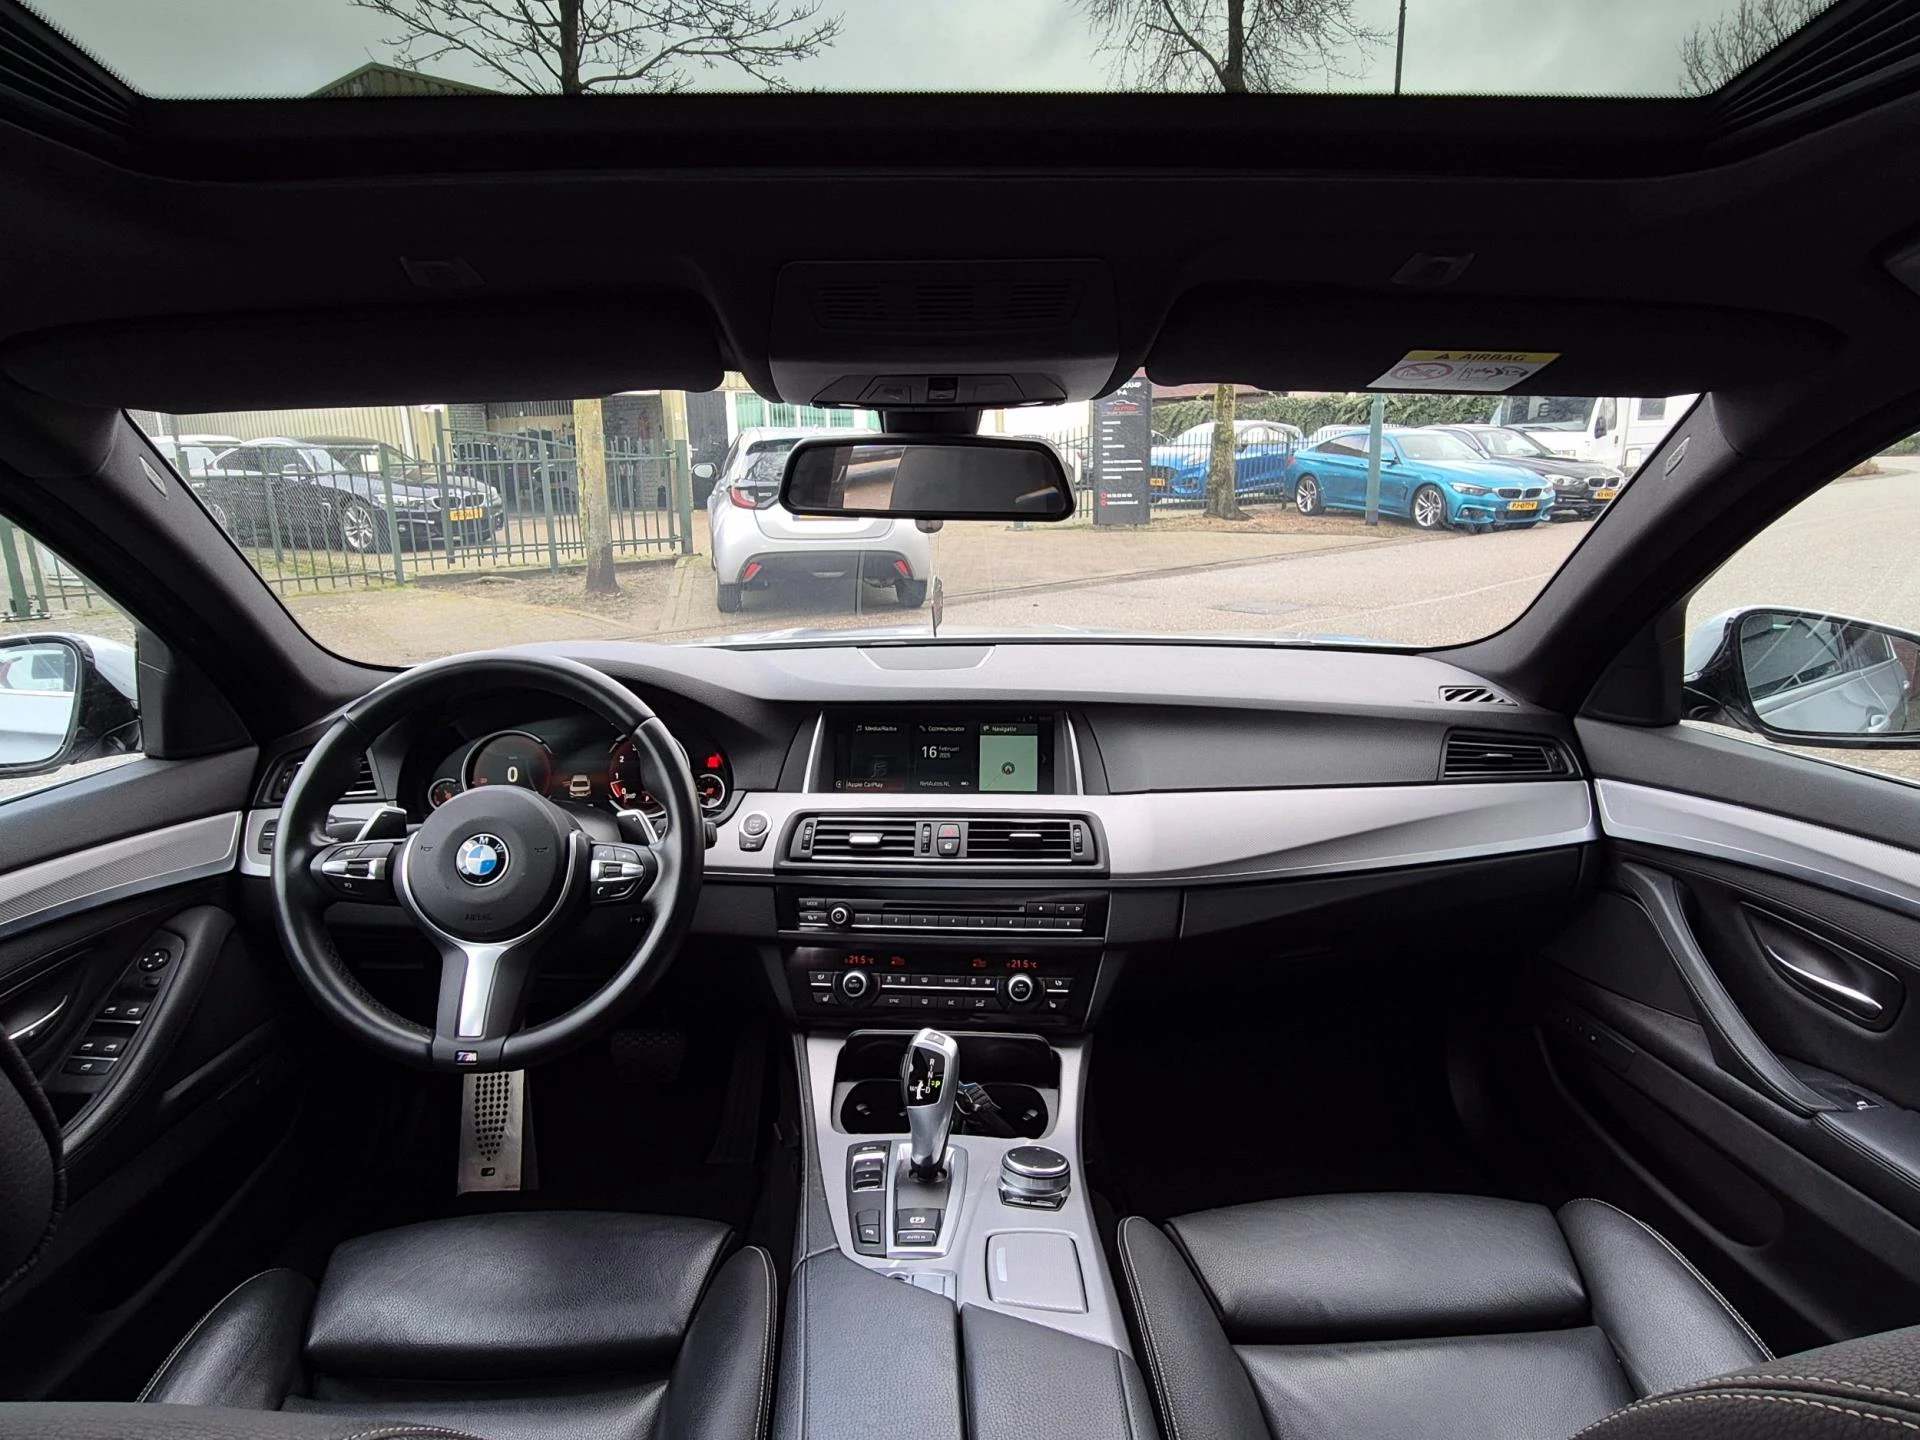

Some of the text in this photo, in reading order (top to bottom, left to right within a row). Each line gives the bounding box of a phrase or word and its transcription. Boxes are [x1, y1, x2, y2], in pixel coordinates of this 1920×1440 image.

[1461, 353, 1526, 361] AIRBAG
[921, 745, 938, 759] 16
[507, 766, 518, 783] 0
[463, 836, 505, 854] BMW
[849, 956, 866, 964] 21.5
[1011, 960, 1029, 968] 21.5
